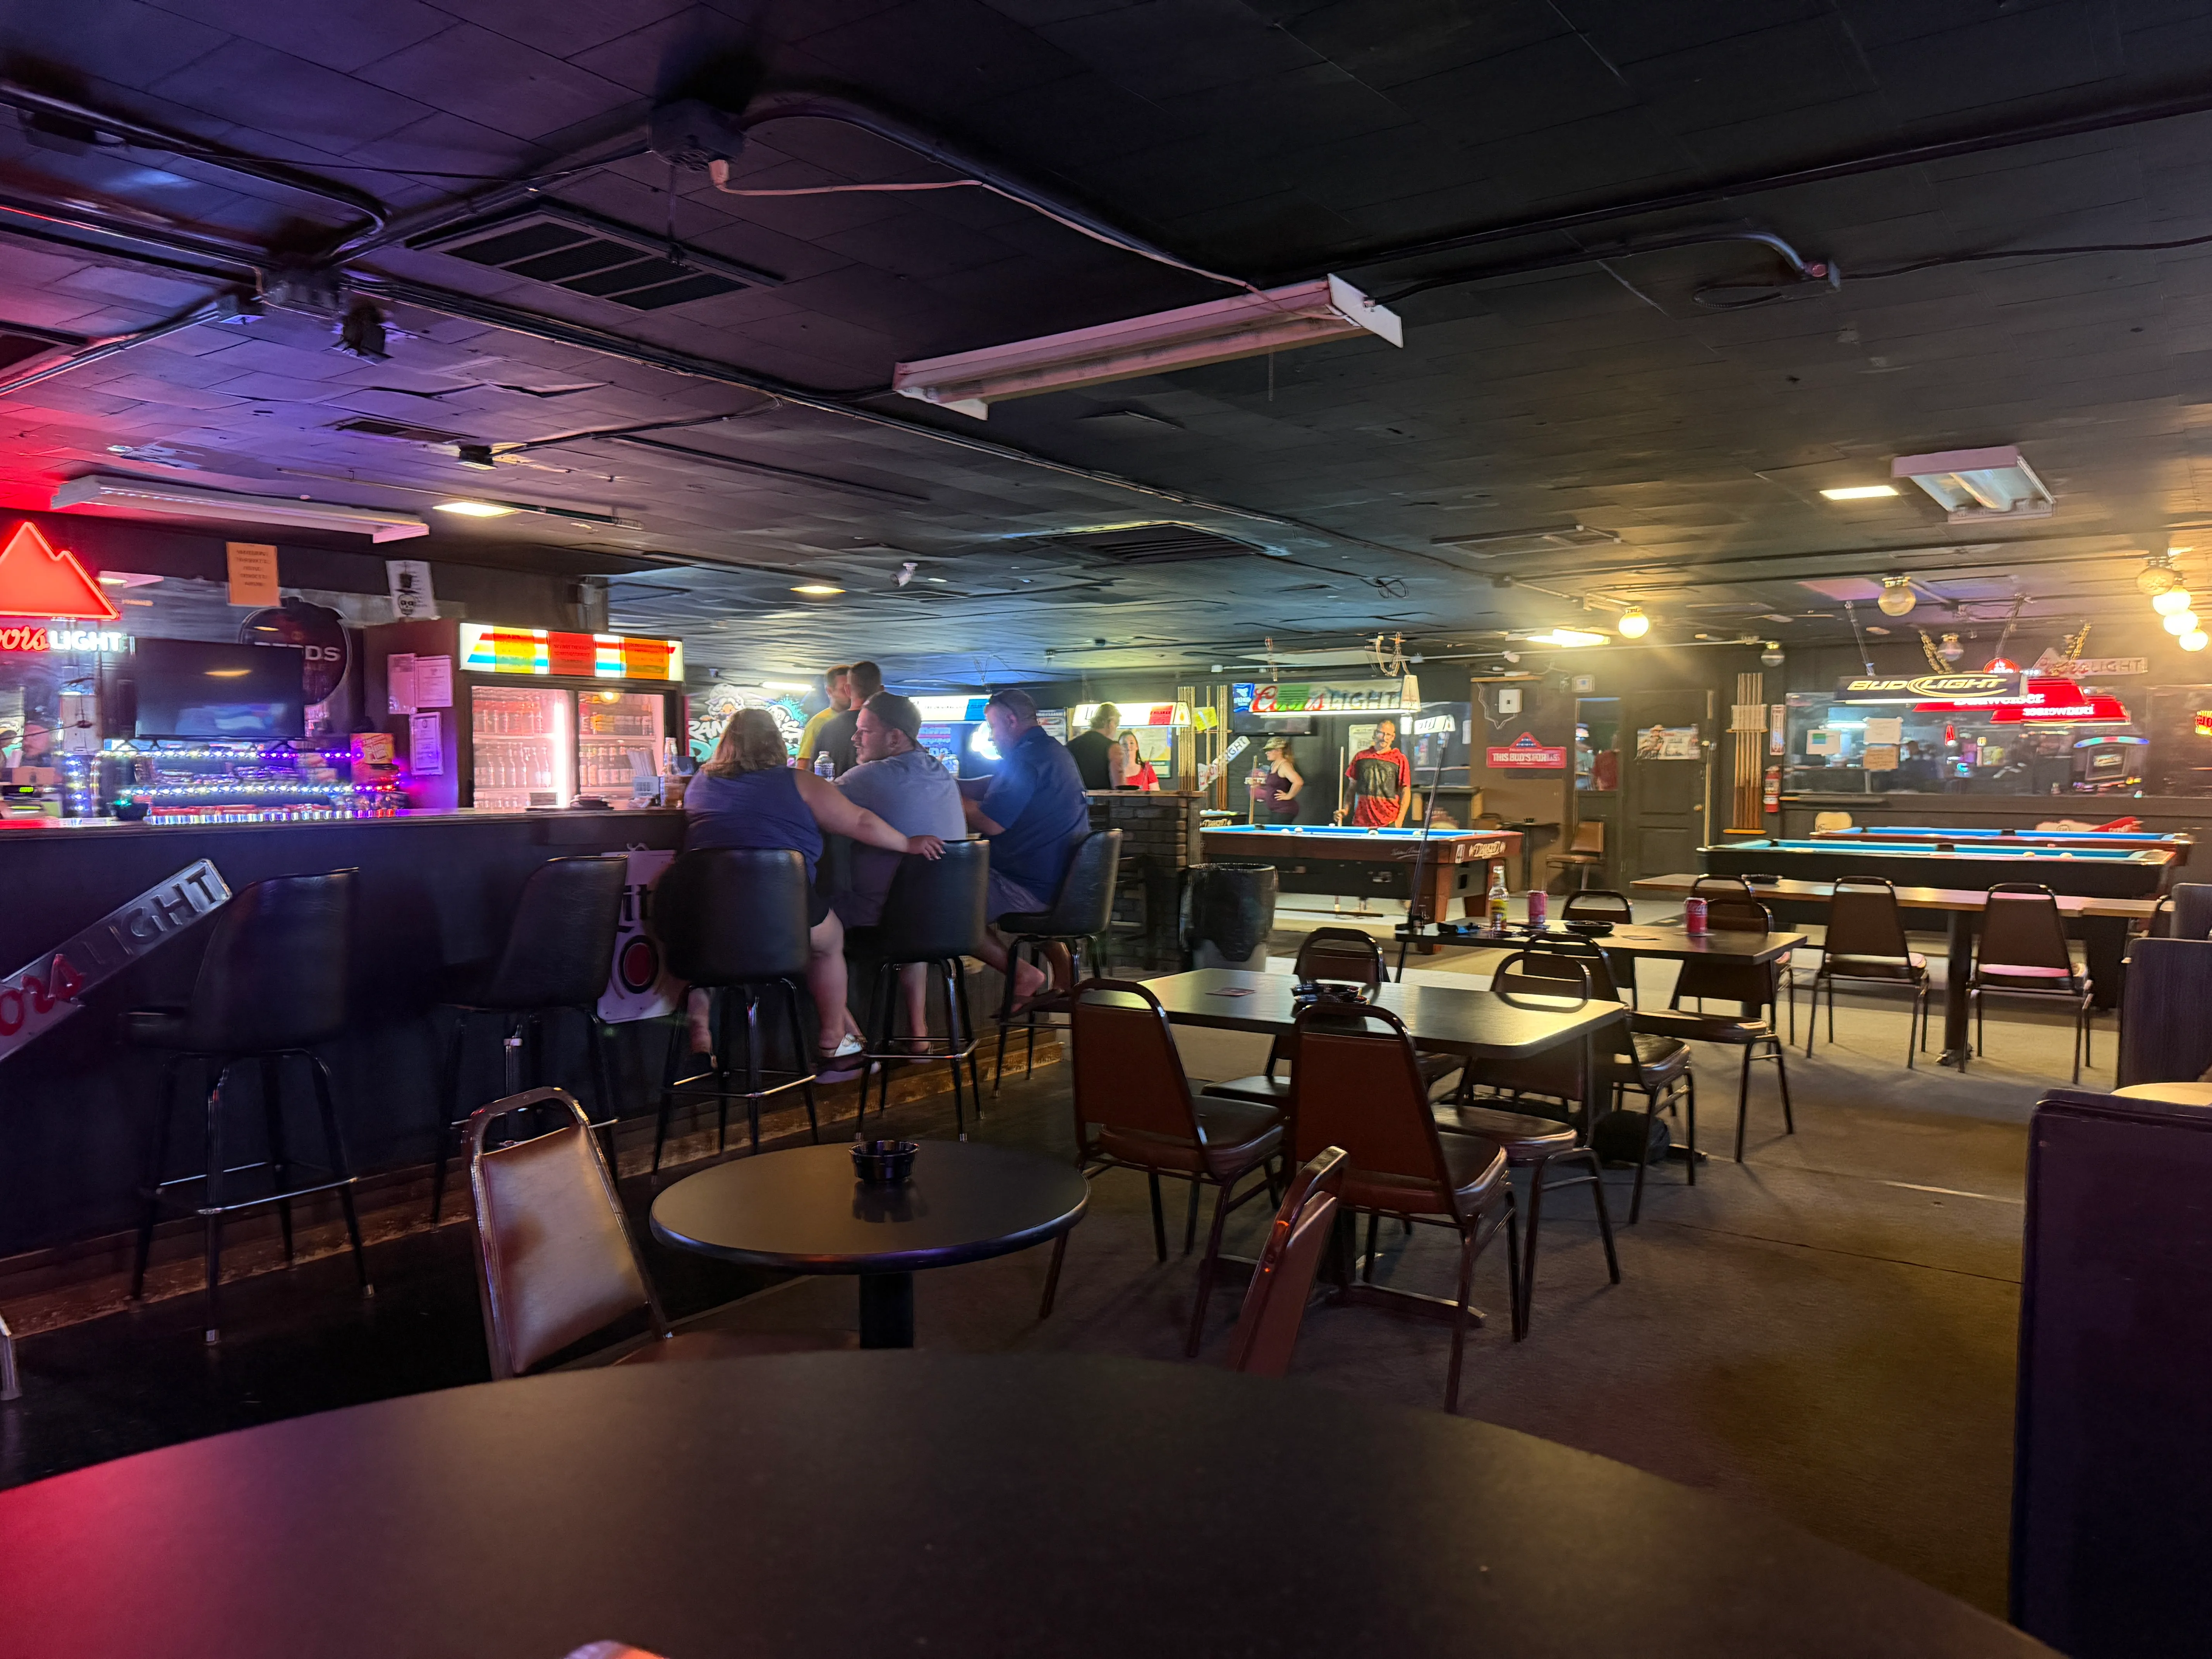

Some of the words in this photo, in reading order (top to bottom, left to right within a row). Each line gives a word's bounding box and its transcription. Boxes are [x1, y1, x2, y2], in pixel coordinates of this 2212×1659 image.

[49, 630, 122, 651] LIGHT
[1848, 680, 1908, 690] BUD
[1921, 678, 2008, 689] LIGHT
[1492, 753, 1509, 762] THIS
[82, 867, 217, 965] LIGHT
